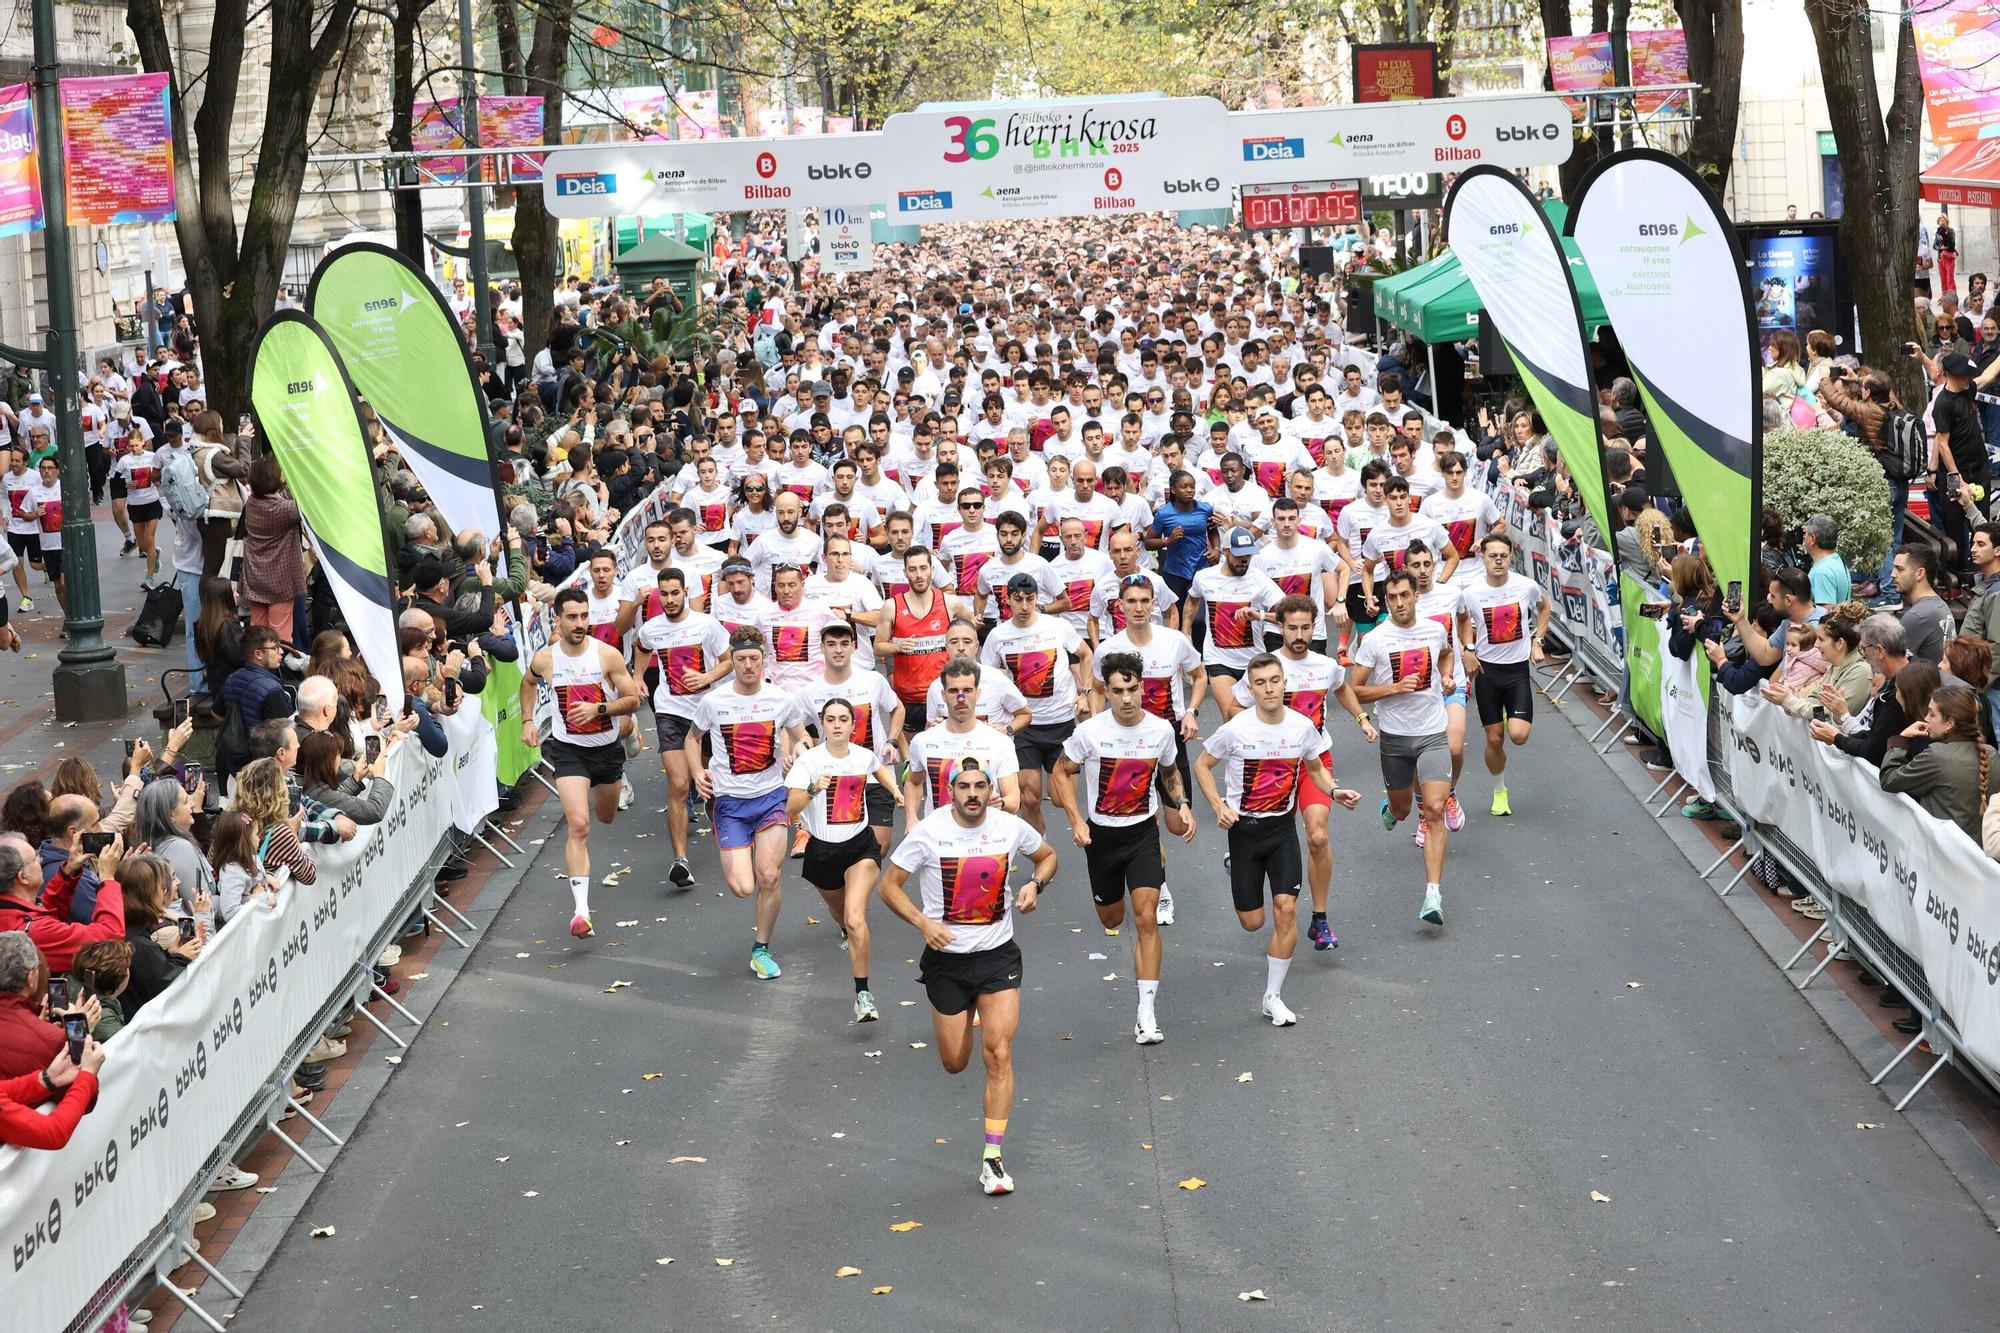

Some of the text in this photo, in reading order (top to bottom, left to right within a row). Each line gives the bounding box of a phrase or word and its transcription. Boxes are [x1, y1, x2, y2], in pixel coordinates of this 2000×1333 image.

[1552, 49, 1574, 62] Fair
[1553, 58, 1612, 75] Saturday
[1018, 112, 1062, 124] Bilboko
[943, 116, 1000, 163] 36
[1346, 132, 1374, 143] aena
[1496, 126, 1540, 142] bbk
[1112, 143, 1140, 154] 2025
[1252, 143, 1294, 160] Deia
[1353, 142, 1387, 150] Aeropuerto
[1397, 140, 1415, 148] Bilbao
[1434, 147, 1481, 162] Bilbao
[657, 169, 685, 179] aena
[808, 164, 851, 180] bbk
[565, 178, 607, 195] Deia
[996, 186, 1021, 197] aena
[1164, 180, 1203, 194] bbk
[1368, 172, 1429, 196] 11:00
[744, 185, 791, 200] Bilbao
[907, 195, 943, 211] Deia
[1094, 196, 1135, 210] Bilbao
[1252, 195, 1357, 225] 00:00:05
[823, 208, 865, 226] 10 km.
